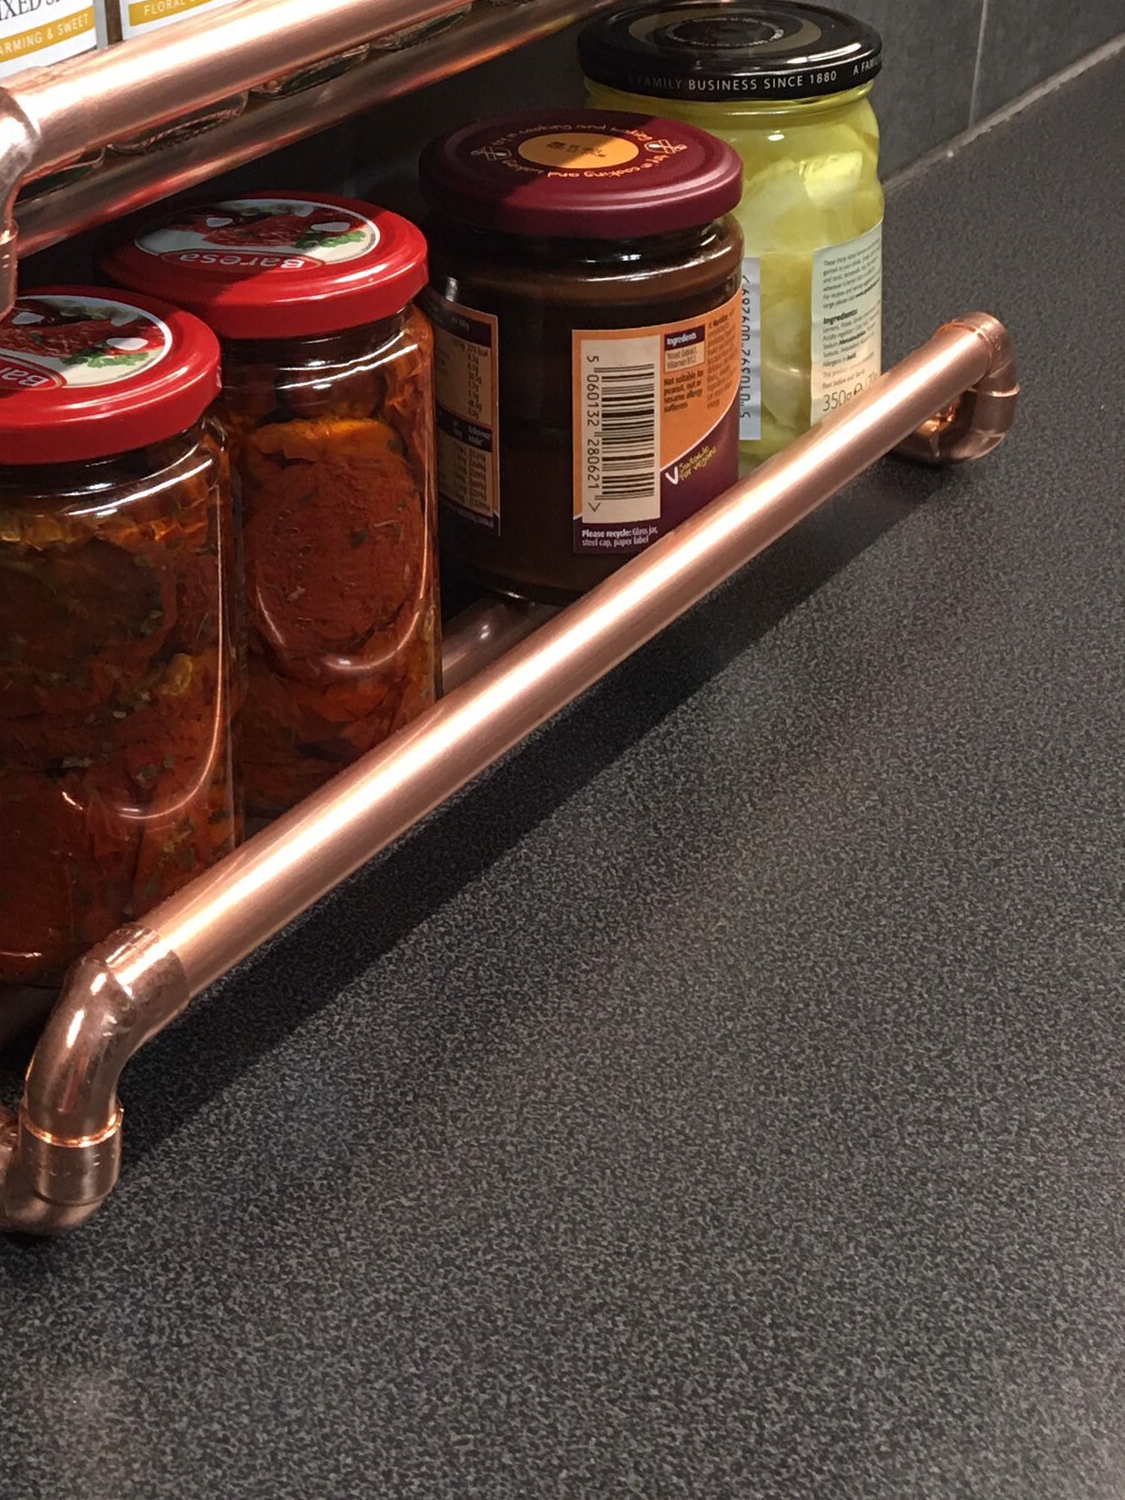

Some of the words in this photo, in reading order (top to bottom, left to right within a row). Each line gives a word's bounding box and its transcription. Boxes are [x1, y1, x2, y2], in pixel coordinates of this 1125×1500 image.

[57, 12, 89, 37] SWEET
[637, 75, 682, 90] FAMILY
[688, 78, 758, 91] BUSINESS
[763, 77, 804, 90] SINCE
[808, 71, 838, 85] 1880
[547, 170, 579, 178] and
[179, 253, 305, 269] Baresa
[666, 332, 697, 346] Ingredients
[586, 374, 600, 427] 060132
[587, 439, 600, 489] 280621
[581, 528, 605, 538] Please
[632, 526, 649, 536] Glass
[581, 538, 598, 547] steel
[613, 538, 632, 548] paper
[633, 535, 649, 545] label
